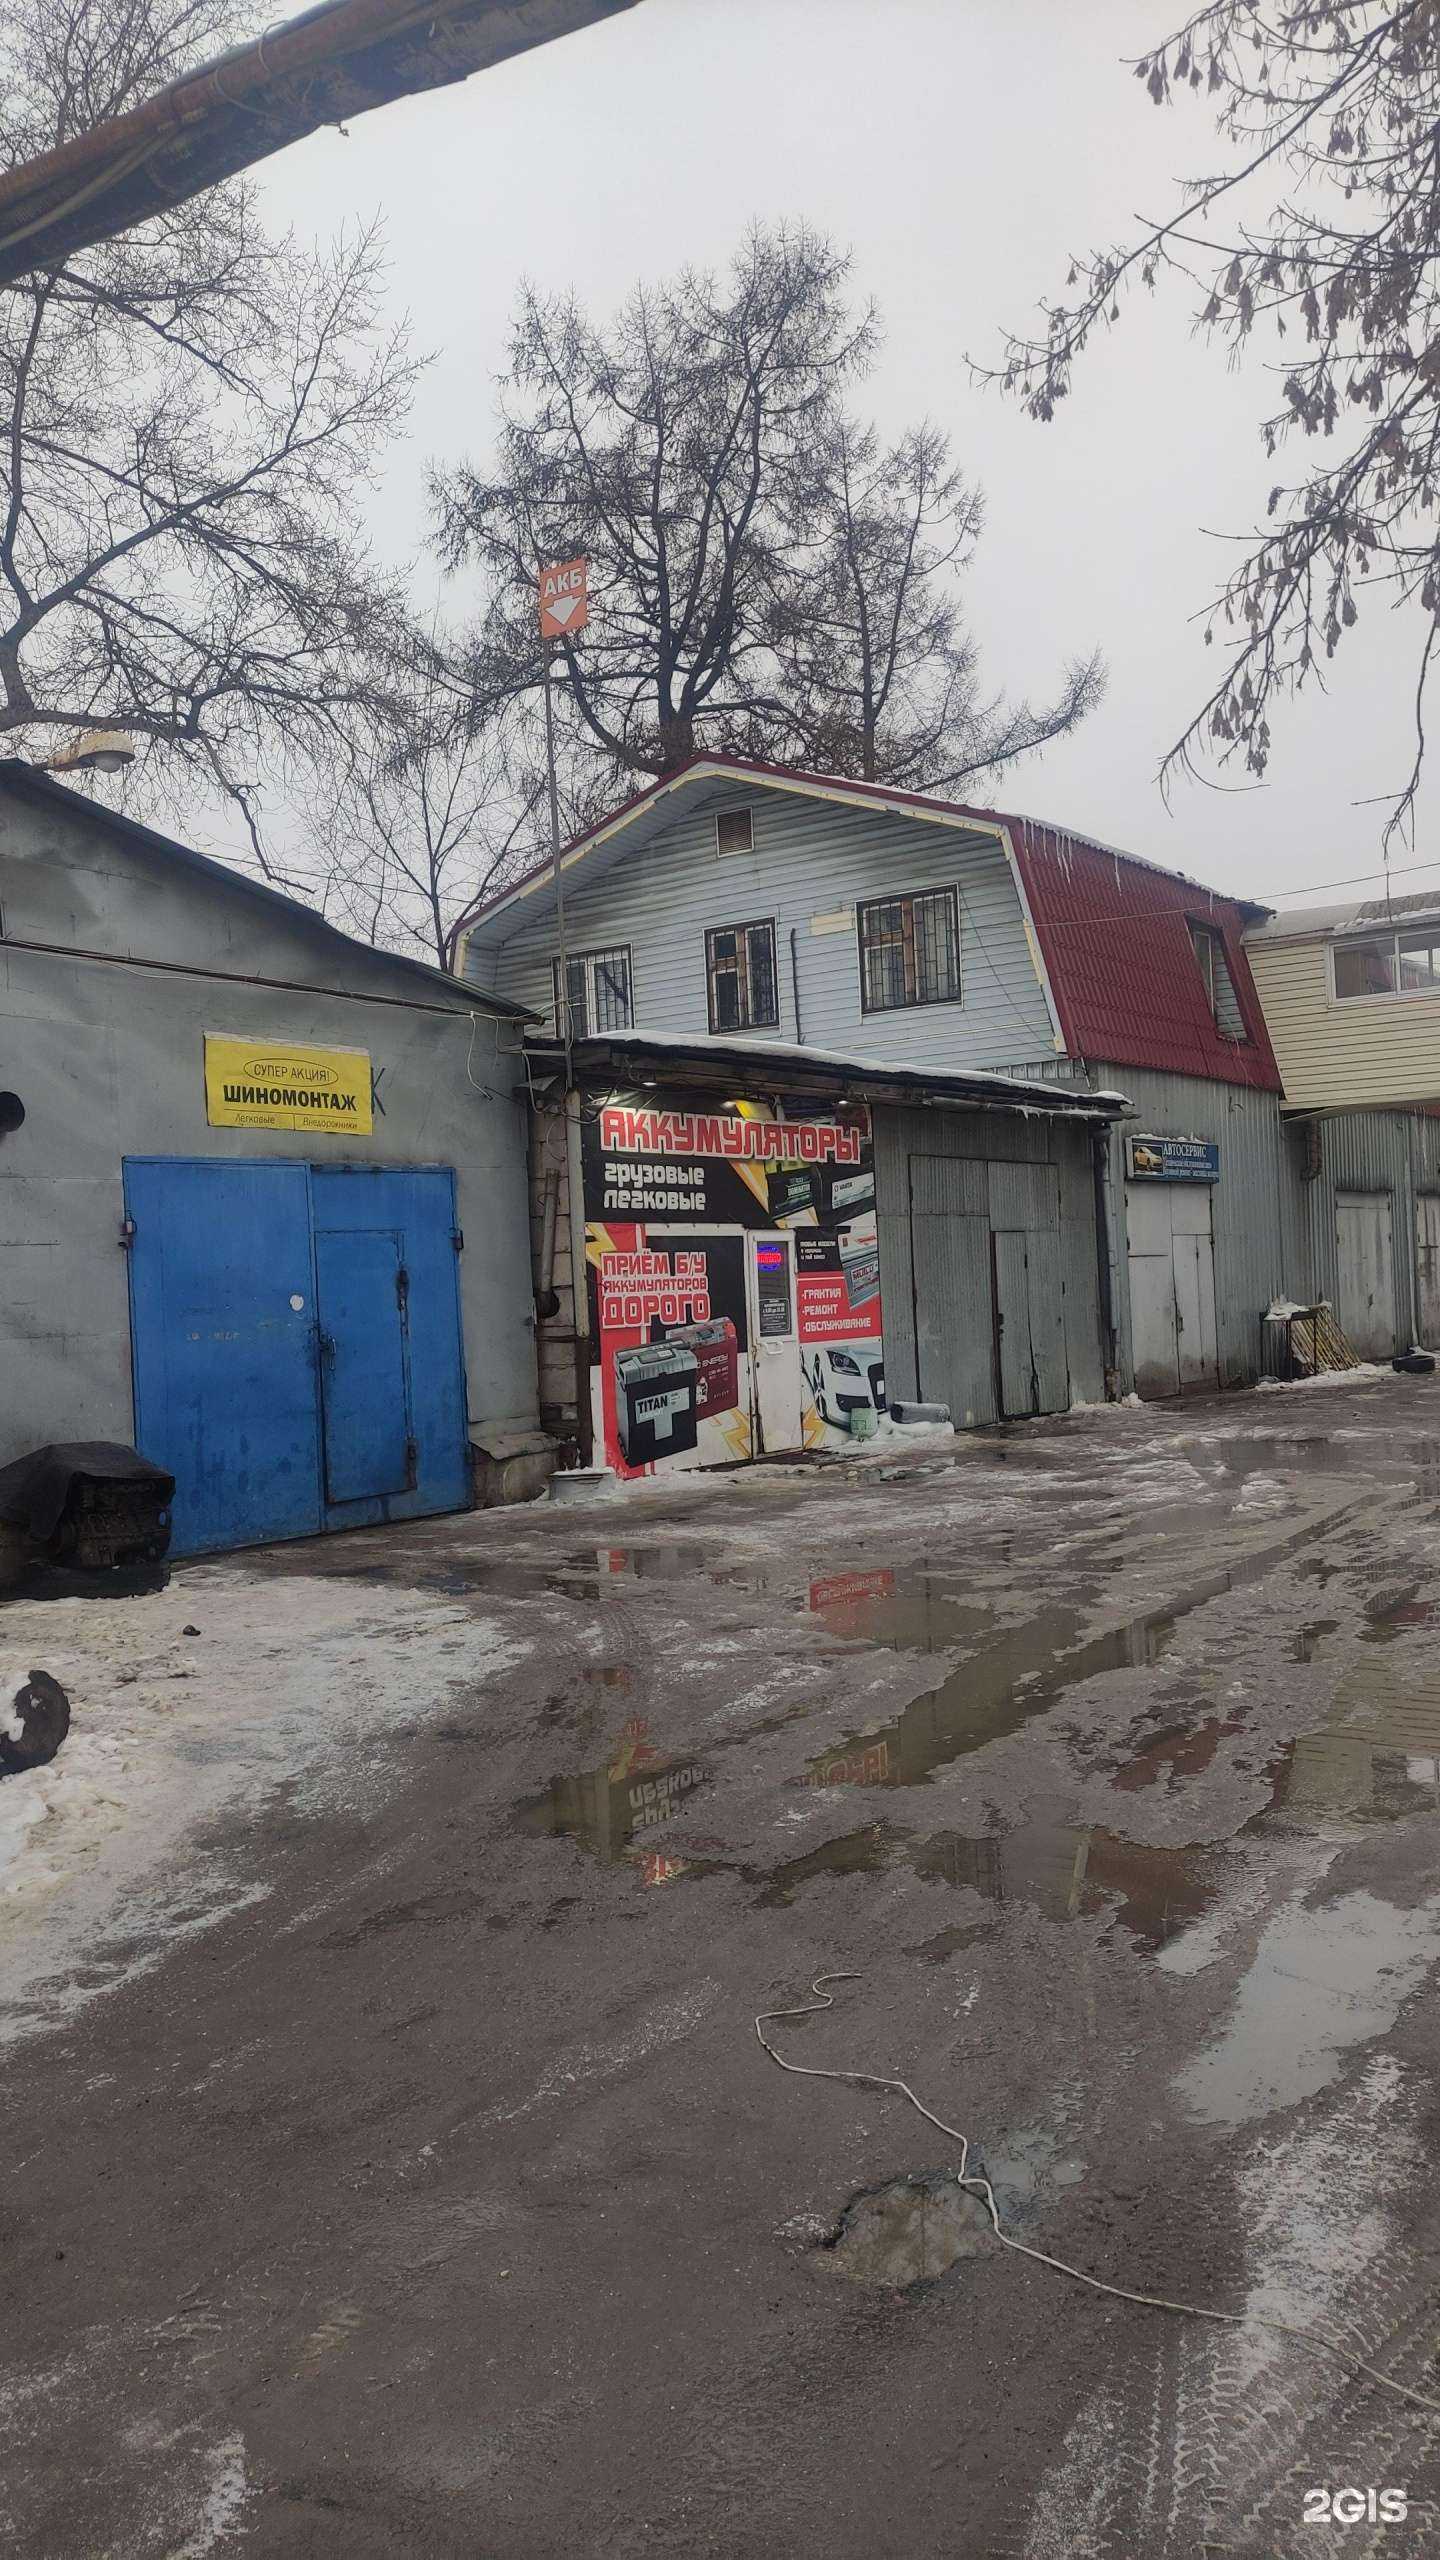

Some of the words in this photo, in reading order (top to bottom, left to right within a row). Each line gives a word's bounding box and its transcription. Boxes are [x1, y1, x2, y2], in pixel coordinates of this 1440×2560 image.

[544, 567, 582, 597] АКБ
[254, 1064, 287, 1078] СУПЕР
[290, 1068, 330, 1082] АКЦИЯ!
[223, 1084, 357, 1112] ШИНОМОНТАЖ
[602, 1108, 860, 1164] АККУМУЛЯТОРЫ
[1163, 1142, 1207, 1158] АВТОСЕРВИС
[602, 1250, 669, 1276] ПРИЁМ
[675, 1253, 705, 1275] Б/У
[603, 1277, 707, 1293] АККУМУЛЯТОРОВ
[603, 1293, 709, 1326] ДОРОГО
[637, 1395, 668, 1414] TITAN
